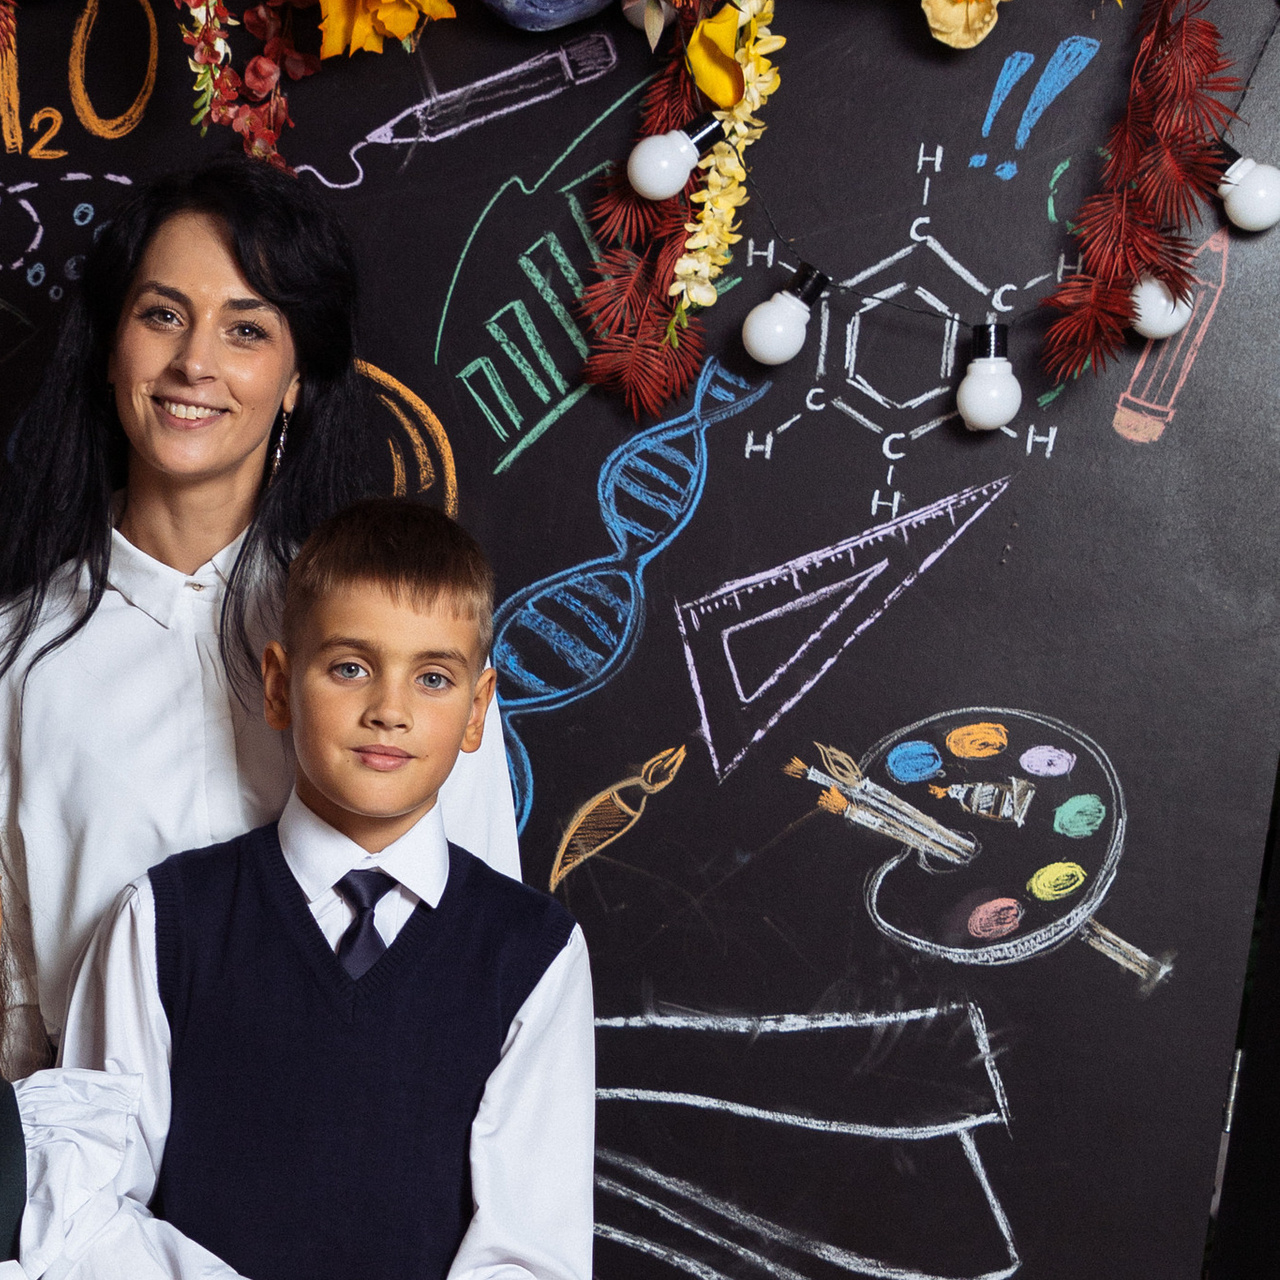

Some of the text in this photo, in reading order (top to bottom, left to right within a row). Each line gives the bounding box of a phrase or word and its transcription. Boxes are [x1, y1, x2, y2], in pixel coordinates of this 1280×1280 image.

[917, 143, 943, 173] H
[910, 217, 930, 242] C
[746, 239, 775, 268] H
[991, 284, 1018, 312] C
[806, 388, 825, 410] C
[745, 431, 773, 459] H
[883, 433, 906, 460] C
[1026, 424, 1058, 458] H
[872, 490, 901, 519] H
